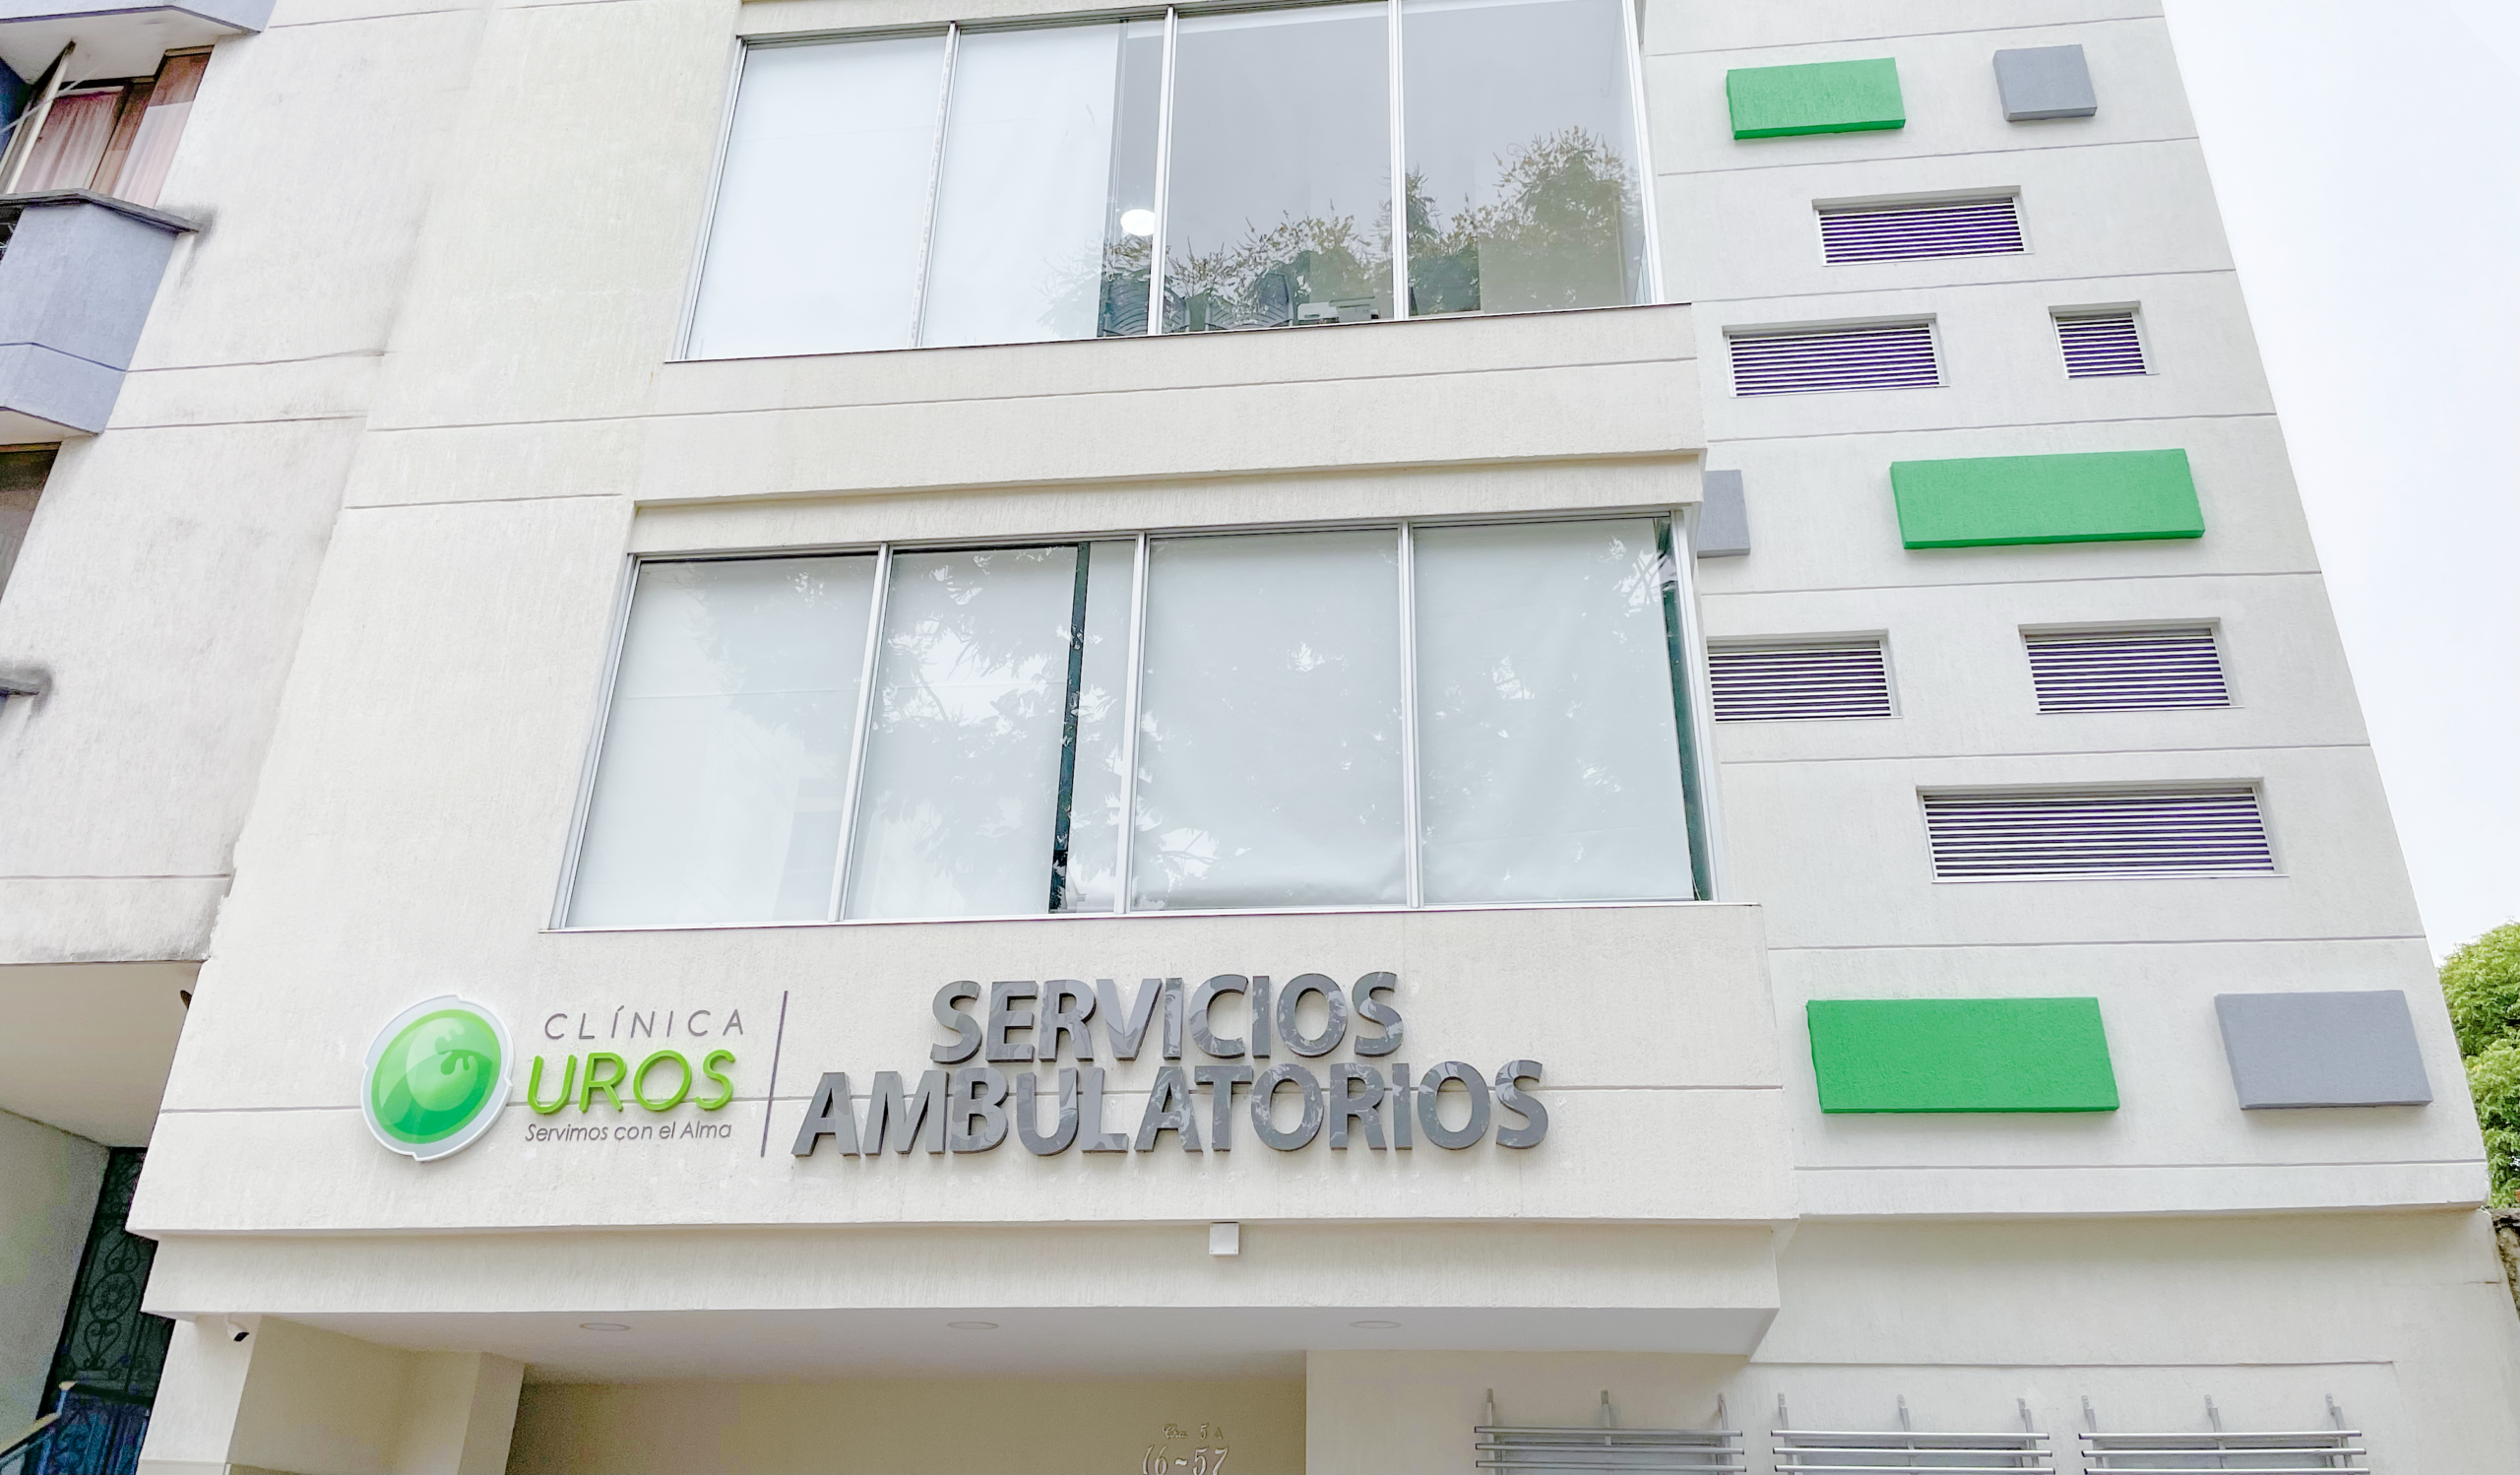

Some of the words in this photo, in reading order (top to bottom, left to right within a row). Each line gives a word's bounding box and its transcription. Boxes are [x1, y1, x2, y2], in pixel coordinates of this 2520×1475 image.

[544, 1005, 744, 1040] CLÍNICA
[930, 972, 1404, 1064] SERVICIOS
[527, 1050, 736, 1114] UROS
[525, 1123, 608, 1142] Servimos
[614, 1125, 653, 1141] con
[659, 1122, 675, 1139] el
[679, 1121, 732, 1140] Alma
[790, 1059, 1548, 1157] AMBULATORIOS
[1200, 1423, 1209, 1440] 5
